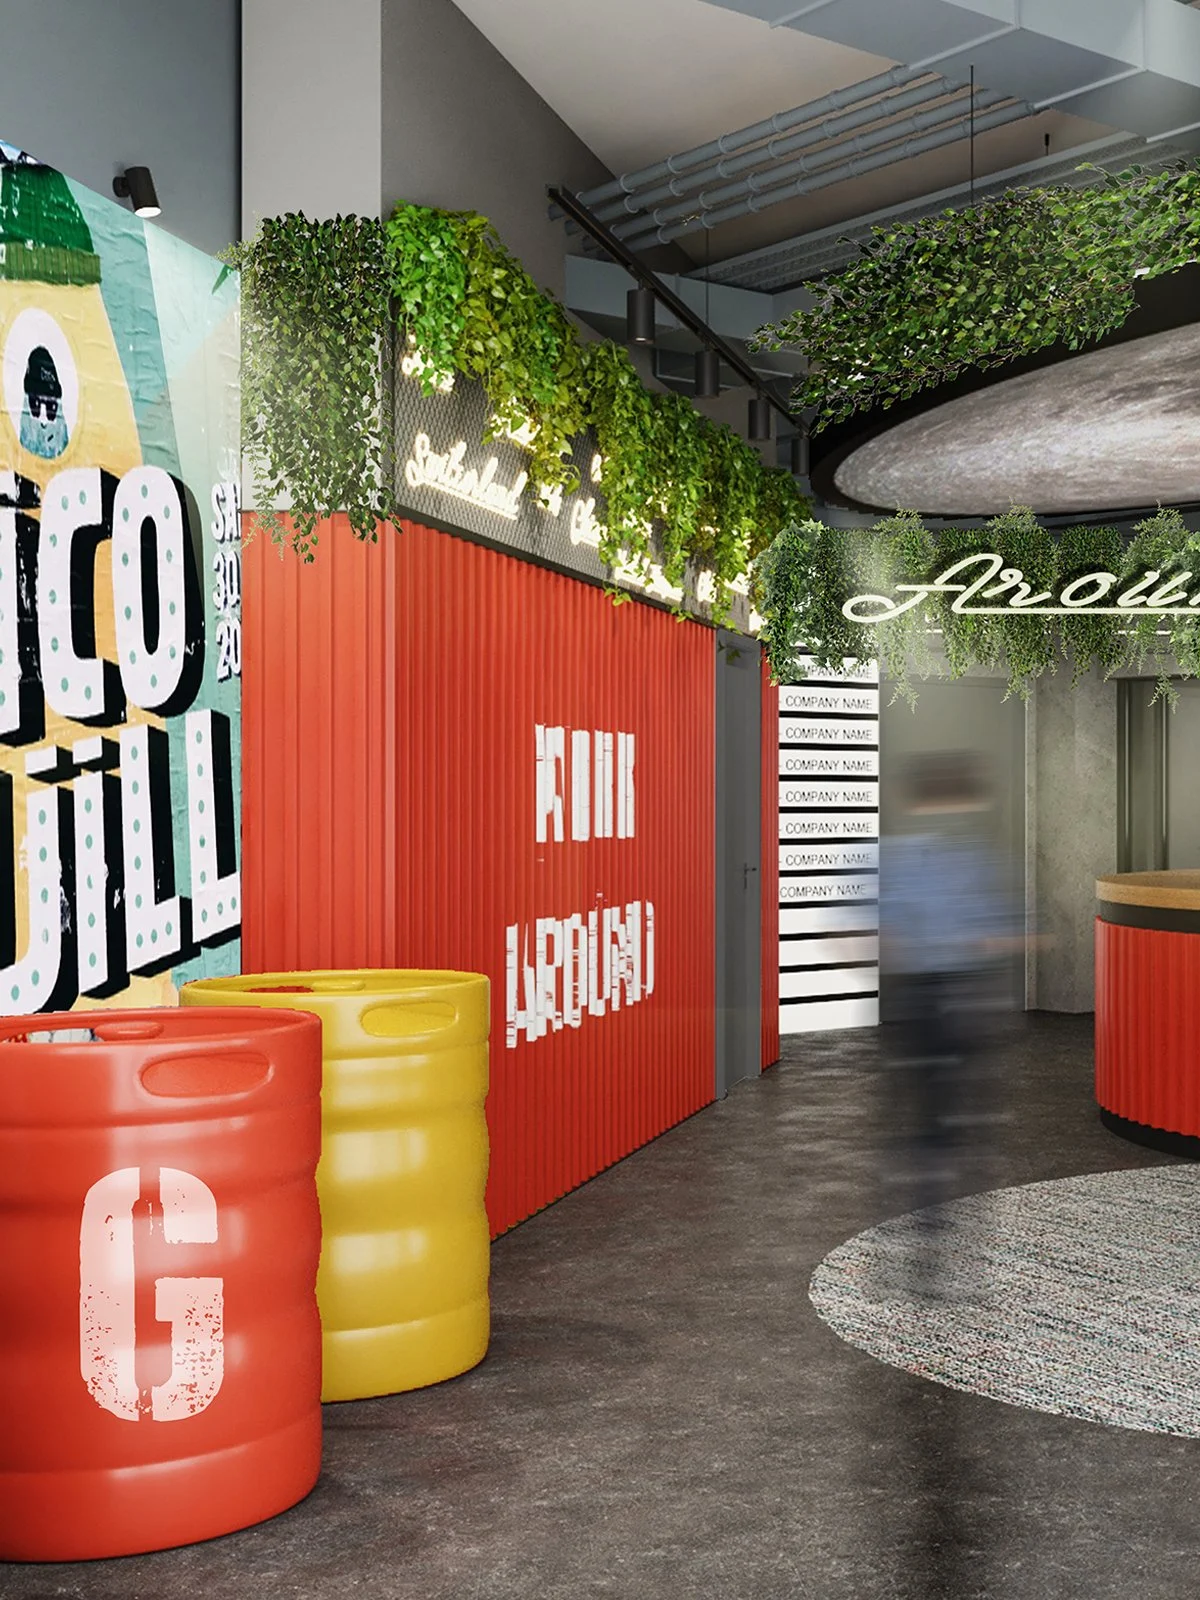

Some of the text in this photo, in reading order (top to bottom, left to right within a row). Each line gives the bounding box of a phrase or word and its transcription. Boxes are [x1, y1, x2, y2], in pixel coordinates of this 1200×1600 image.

[785, 695, 872, 710] COMPANY NAME
[785, 727, 872, 741] COMPANY NAME
[785, 759, 872, 772] COMPANY NAME
[785, 791, 872, 803] COMPANY NAME
[785, 822, 872, 834] COMPANY NAME
[785, 853, 872, 866] COMPANY NAME
[780, 885, 833, 898] COMPANY
[79, 1167, 224, 1422] G
